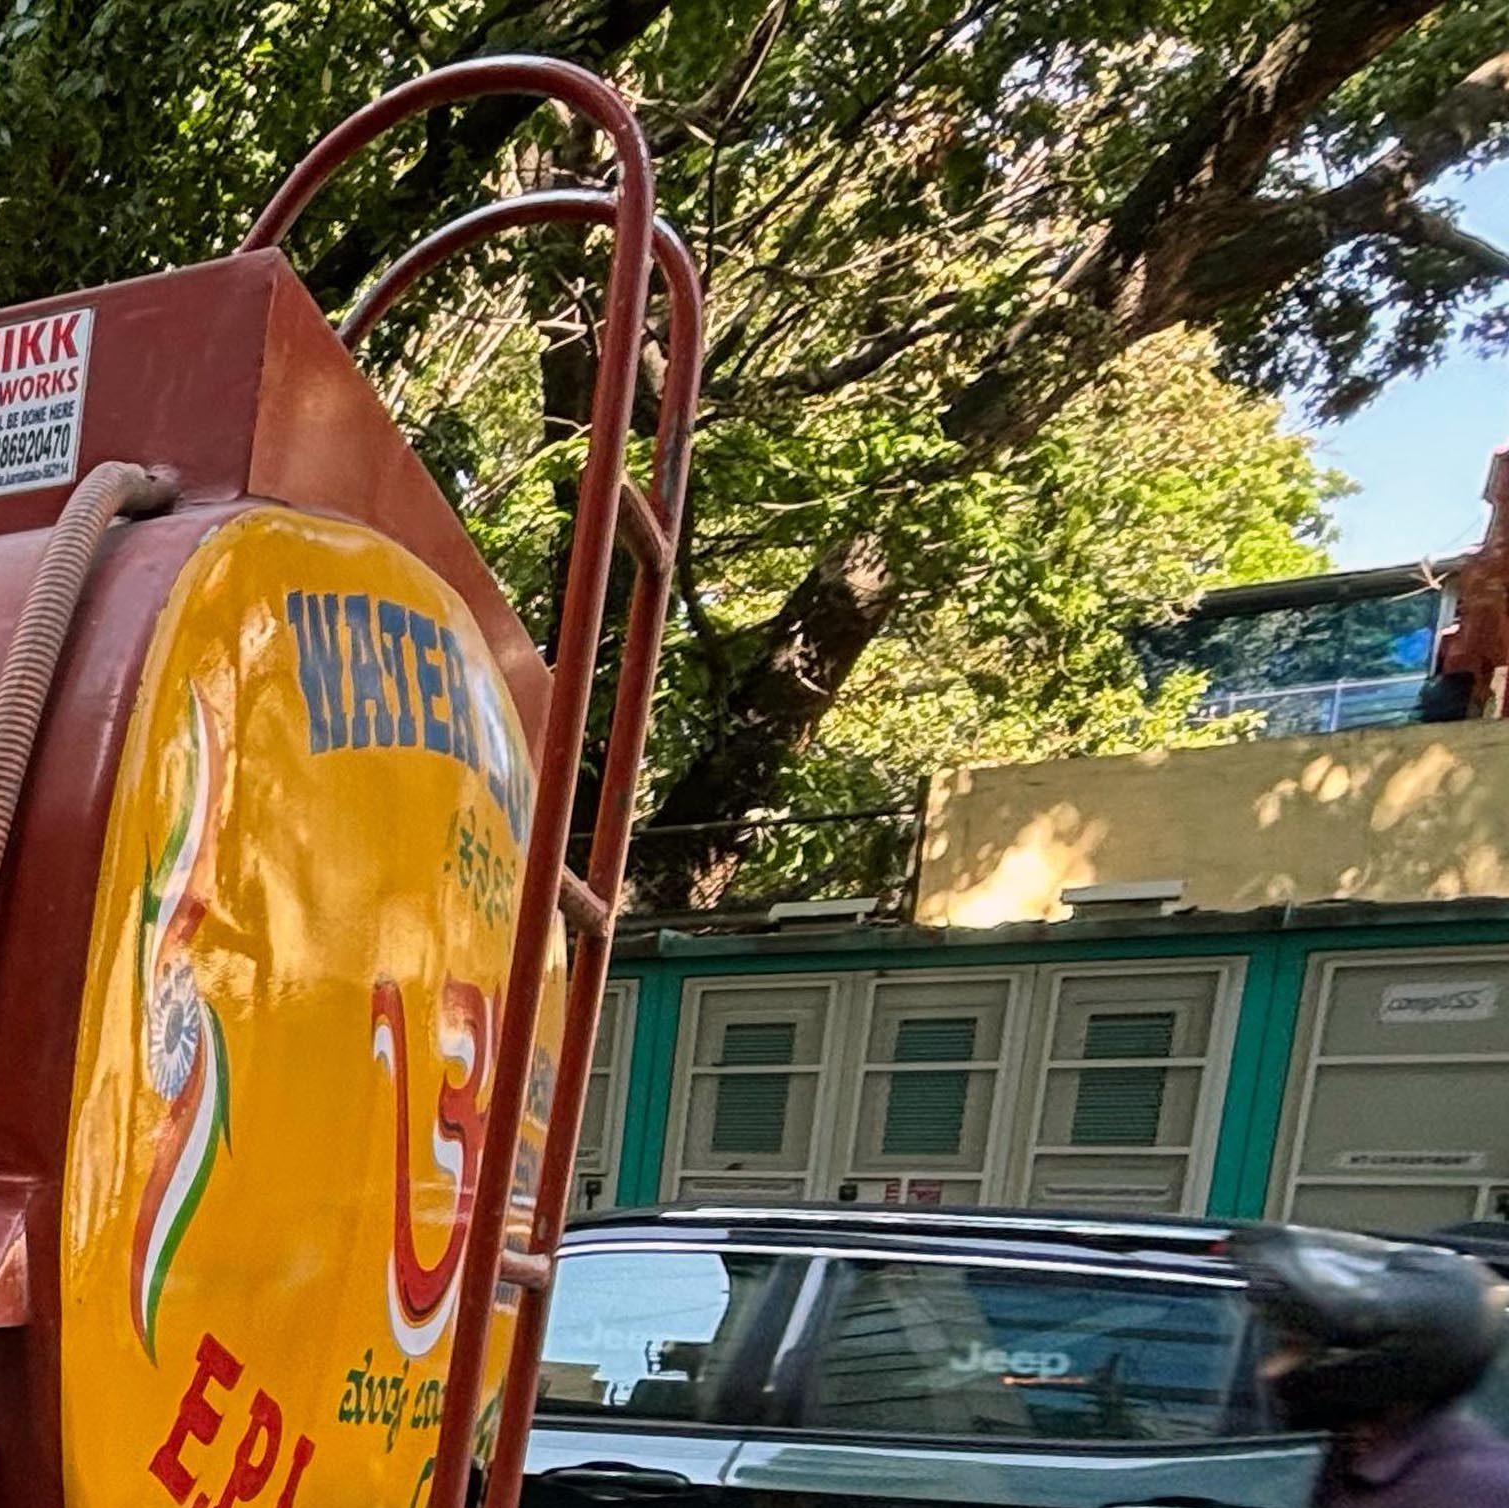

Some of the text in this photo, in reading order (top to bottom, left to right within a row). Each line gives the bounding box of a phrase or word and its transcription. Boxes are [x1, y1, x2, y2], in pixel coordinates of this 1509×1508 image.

[7, 411, 20, 430] BE
[21, 405, 47, 427] DONE
[49, 400, 76, 421] HERE
[286, 590, 480, 773] WATER
[946, 1339, 1070, 1378] Jeep
